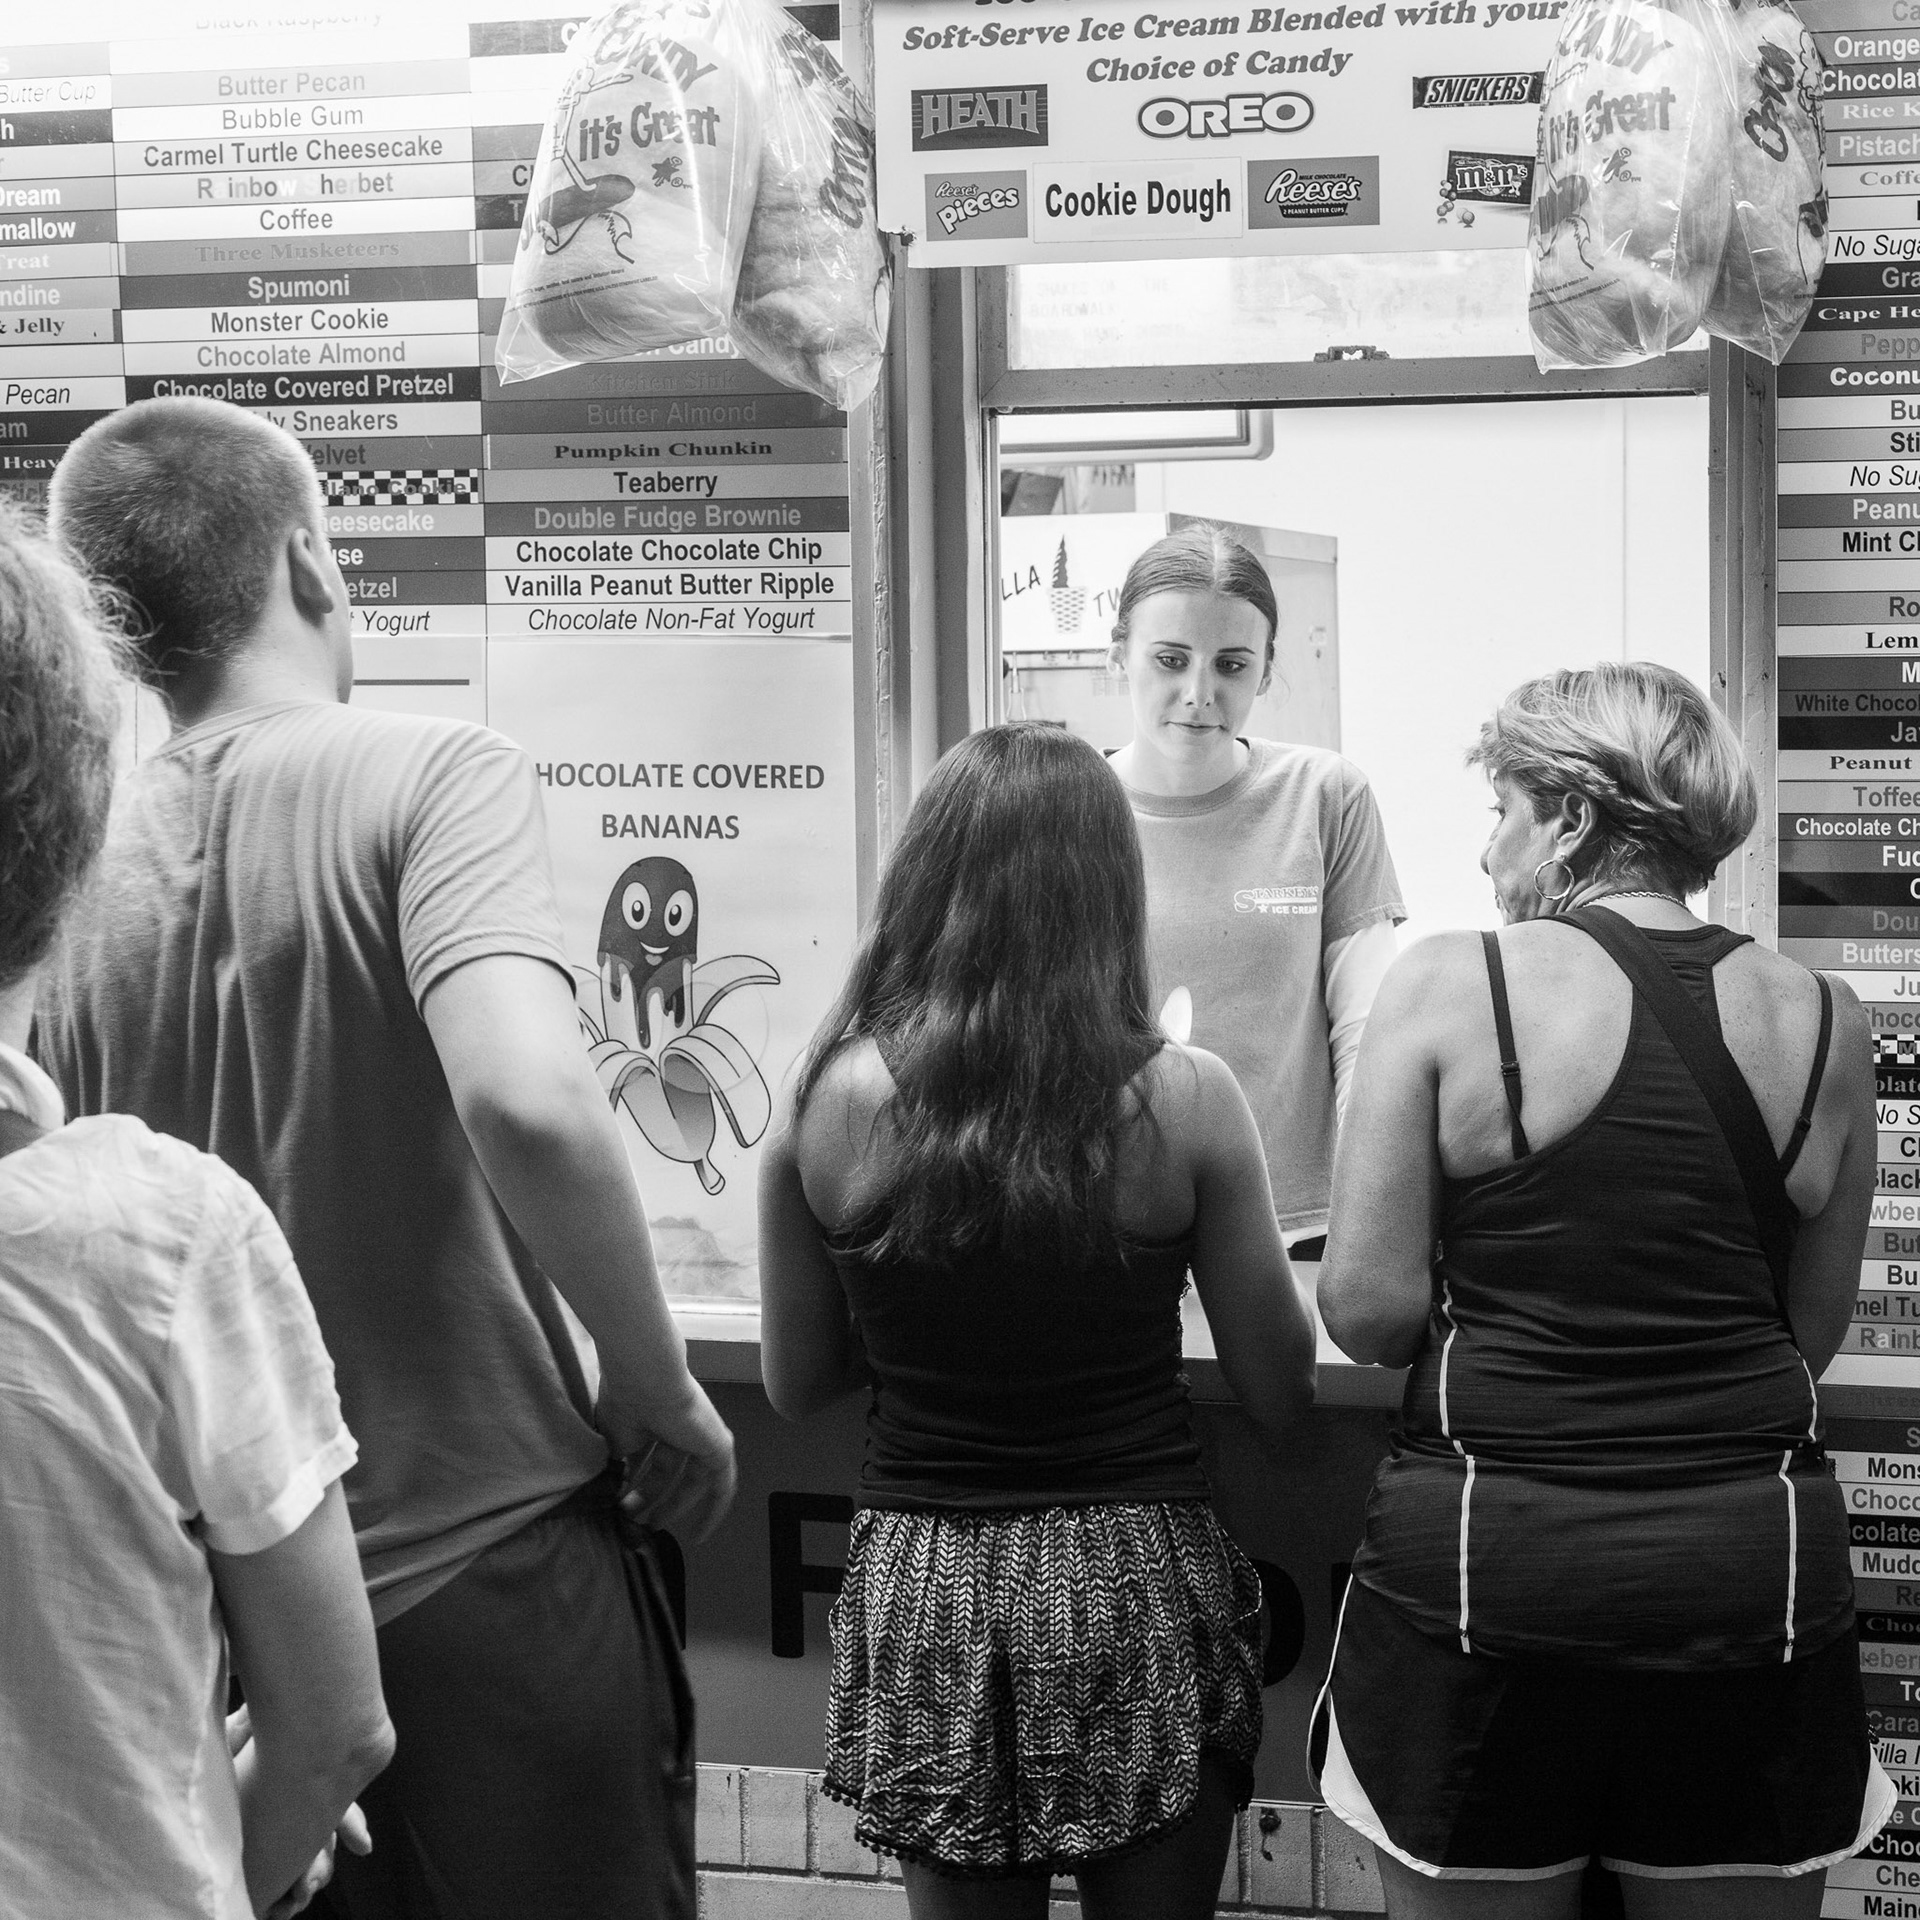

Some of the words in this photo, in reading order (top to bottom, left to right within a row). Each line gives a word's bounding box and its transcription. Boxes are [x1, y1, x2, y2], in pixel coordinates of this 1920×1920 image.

[902, 22, 1070, 51] Soft-Serve
[1077, 17, 1125, 42] Ice
[1134, 14, 1240, 40] Cream
[1247, 2, 1387, 34] Blended
[1395, 0, 1476, 26] with
[1484, 0, 1568, 28] your
[1834, 36, 1920, 62] Orange
[1086, 56, 1196, 83] Choice
[1203, 51, 1240, 78] of
[1246, 47, 1354, 77] Candy
[59, 80, 96, 104] Cup
[218, 74, 289, 96] Butter
[296, 71, 366, 94] Pecan
[1427, 76, 1531, 104] SNICKERS
[222, 106, 302, 131] Bubble
[311, 105, 364, 126] Gum
[920, 90, 1040, 139] HEATH
[1138, 91, 1313, 138] OREO
[1842, 104, 1895, 119] Rice
[144, 143, 224, 168] Carmel
[231, 140, 298, 164] Turtle
[306, 134, 443, 161] Cheesecake
[935, 181, 979, 198] Reese's
[1265, 168, 1362, 203] Reese's
[936, 187, 1019, 235] pieces
[1045, 181, 1138, 217] Cookie
[1147, 178, 1231, 222] Dough
[260, 208, 333, 230] Coffee
[195, 246, 263, 262] Three
[271, 243, 400, 260] Musketeers
[1835, 235, 1865, 257] No
[248, 274, 350, 303] Spumoni
[14, 317, 65, 336] Jelly
[211, 311, 302, 333] Monster
[311, 308, 389, 331] Cookie
[1818, 307, 1881, 323] Cape
[197, 344, 311, 368] Chocolate
[319, 341, 405, 365] Almond
[6, 383, 70, 405] Pecan
[153, 377, 267, 400] Chocolate
[275, 375, 369, 398] Covered
[376, 373, 454, 397] Pretzel
[293, 409, 398, 432] Sneakers
[587, 402, 659, 426] Butter
[667, 399, 756, 424] Almond
[554, 444, 660, 461] Pumpkin
[669, 441, 773, 457] Chunkin
[387, 479, 466, 496] Cookie
[613, 471, 718, 497] Teaberry
[1850, 466, 1881, 487] No
[535, 506, 616, 529] Double
[624, 505, 697, 533] Fudge
[705, 504, 801, 527] Brownie
[516, 540, 633, 562] Chocolate
[641, 538, 760, 561] Chocolate
[768, 537, 822, 564] Chip
[1843, 531, 1891, 552] Mint
[505, 574, 582, 596] Vanilla
[590, 573, 672, 595] Peanut
[680, 571, 752, 594] Butter
[760, 571, 835, 600] Ripple
[362, 610, 430, 636] Yogurt
[528, 607, 638, 630] Chocolate
[645, 606, 735, 629] Non-Fat
[745, 605, 815, 633] Yogurt
[1795, 694, 1849, 712] White
[1829, 755, 1913, 770] Peanut
[693, 764, 825, 789] COVERED
[601, 814, 740, 840] BANANAS
[1796, 818, 1891, 836] Chocolate
[1272, 905, 1289, 914] ICE
[1292, 905, 1317, 914] CREAM
